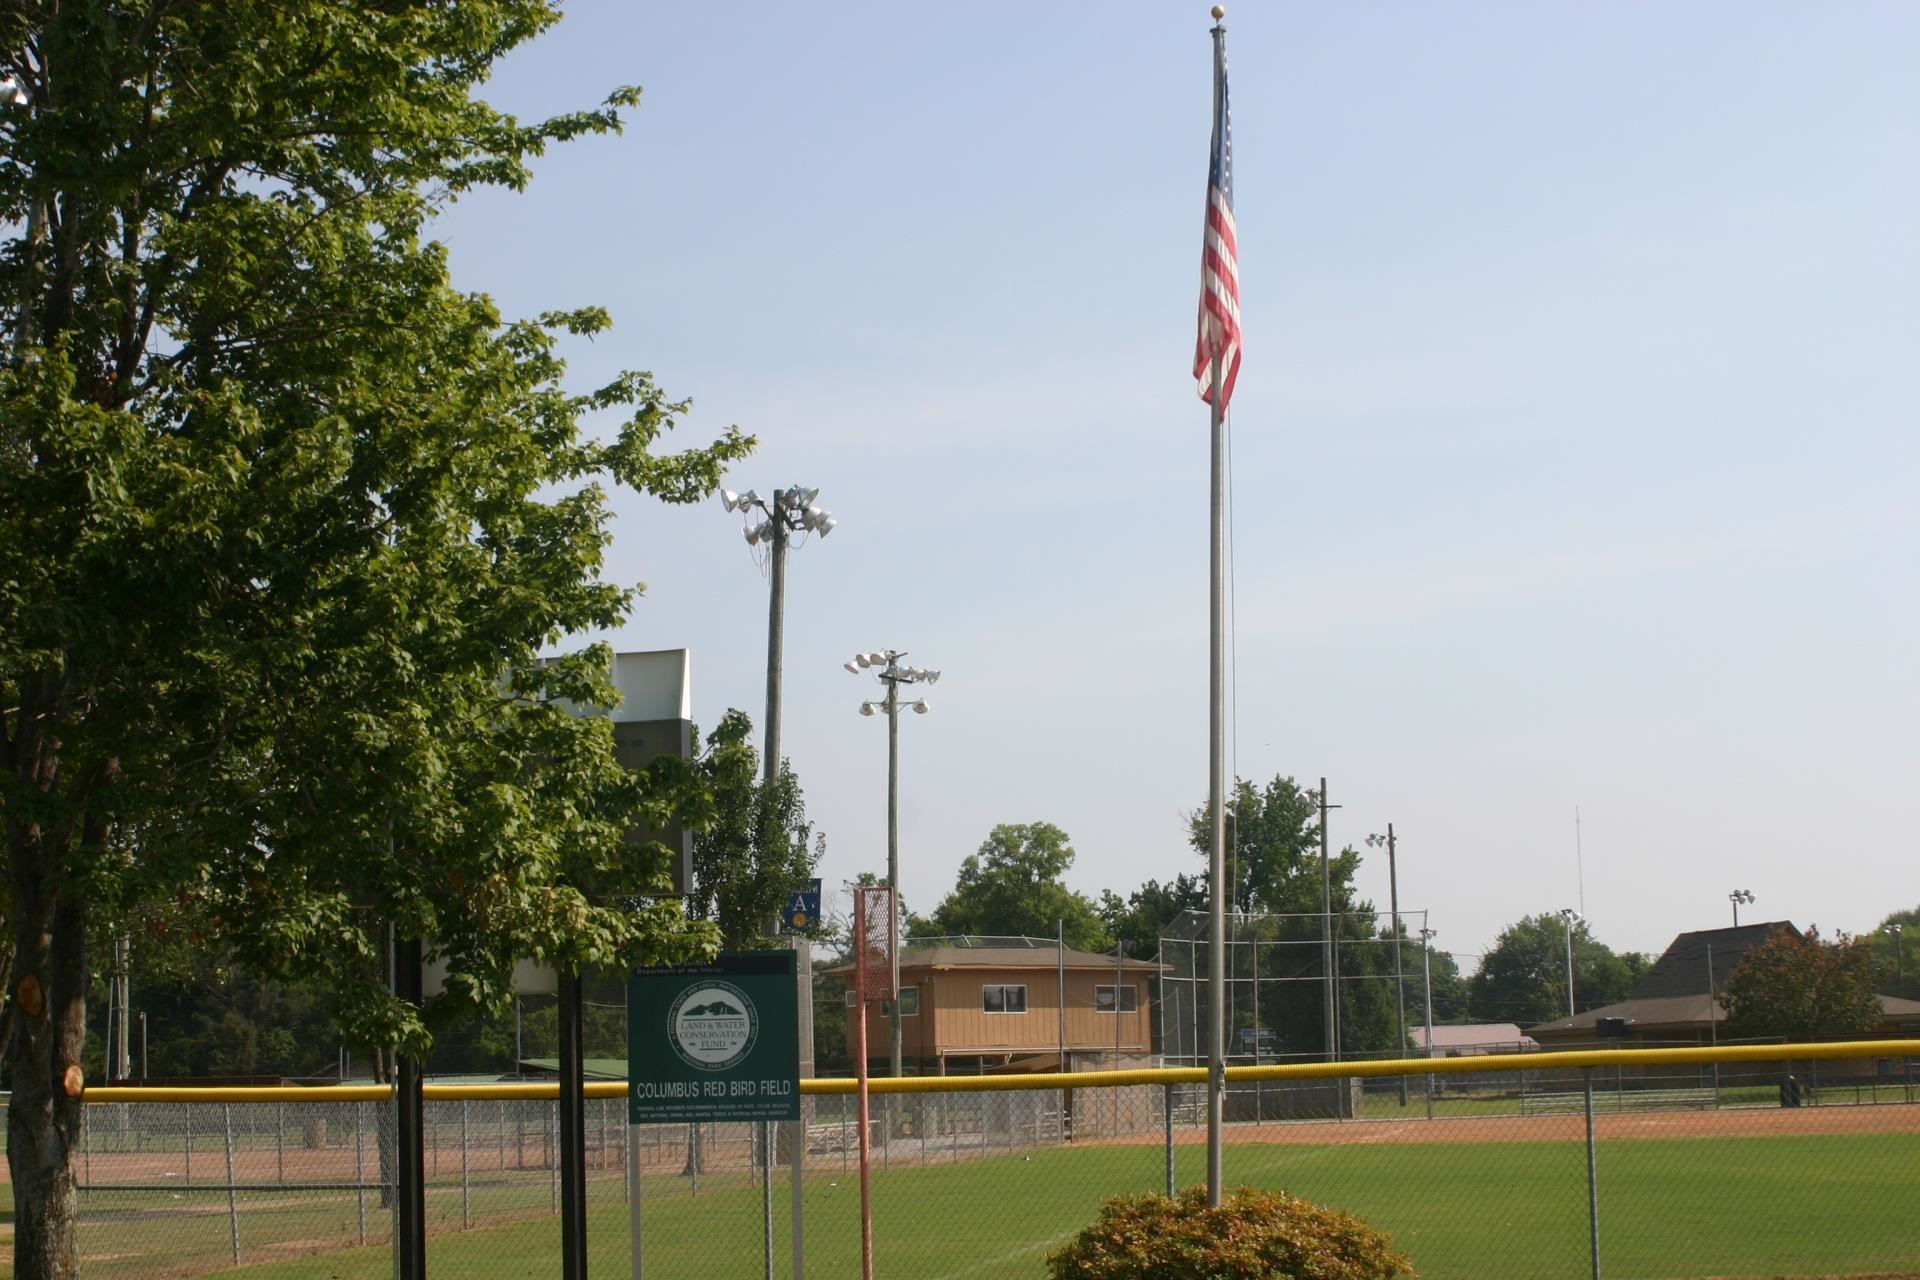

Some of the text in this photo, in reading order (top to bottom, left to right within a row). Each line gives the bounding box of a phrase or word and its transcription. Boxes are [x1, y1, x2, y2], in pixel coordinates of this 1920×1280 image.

[792, 895, 808, 911] A
[680, 1022, 706, 1030] LAND
[714, 1021, 746, 1029] WATER
[679, 1030, 747, 1039] CONSERVATION
[701, 1040, 726, 1048] FUND
[637, 1079, 791, 1099] COLUMBUS RED BIRD FIELD
